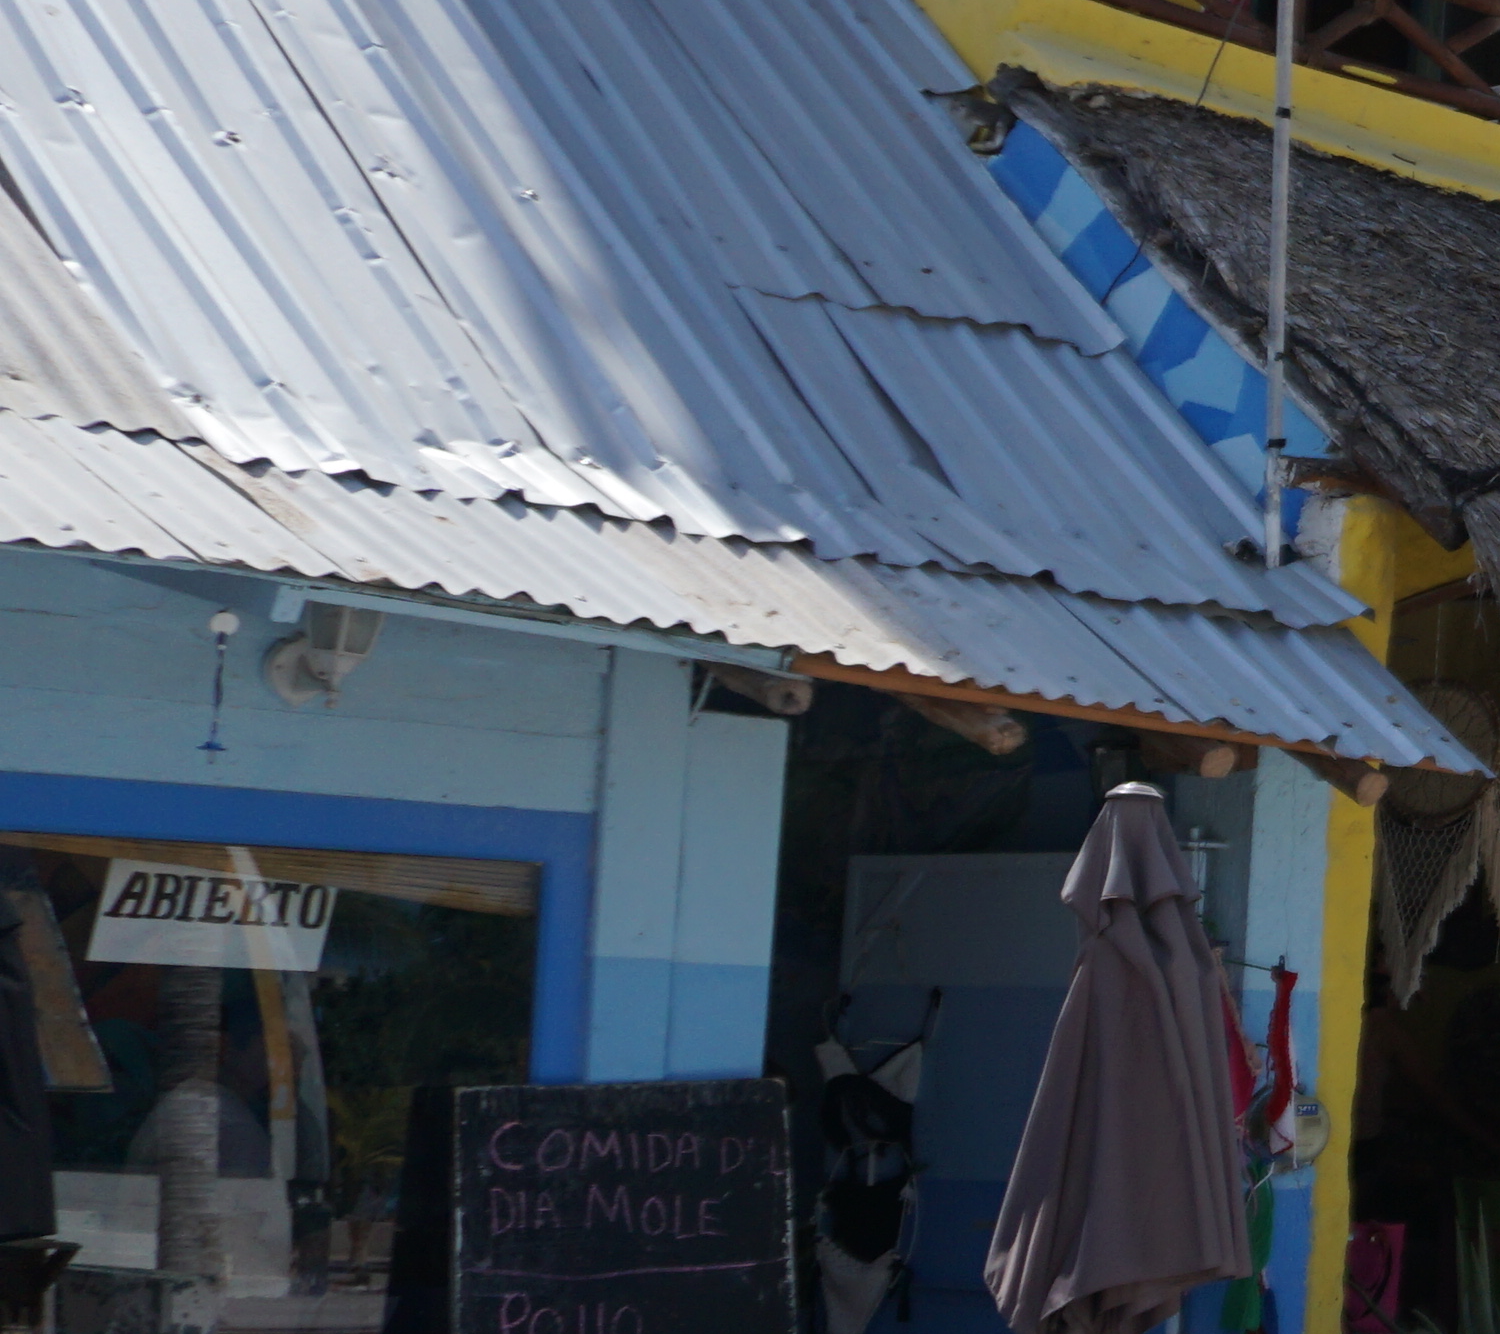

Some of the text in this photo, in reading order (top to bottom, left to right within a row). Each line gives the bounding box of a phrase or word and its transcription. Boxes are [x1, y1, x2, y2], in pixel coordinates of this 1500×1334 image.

[103, 871, 330, 930] ABIERTO
[489, 1121, 700, 1173] COMIDA
[489, 1188, 562, 1237] DIA
